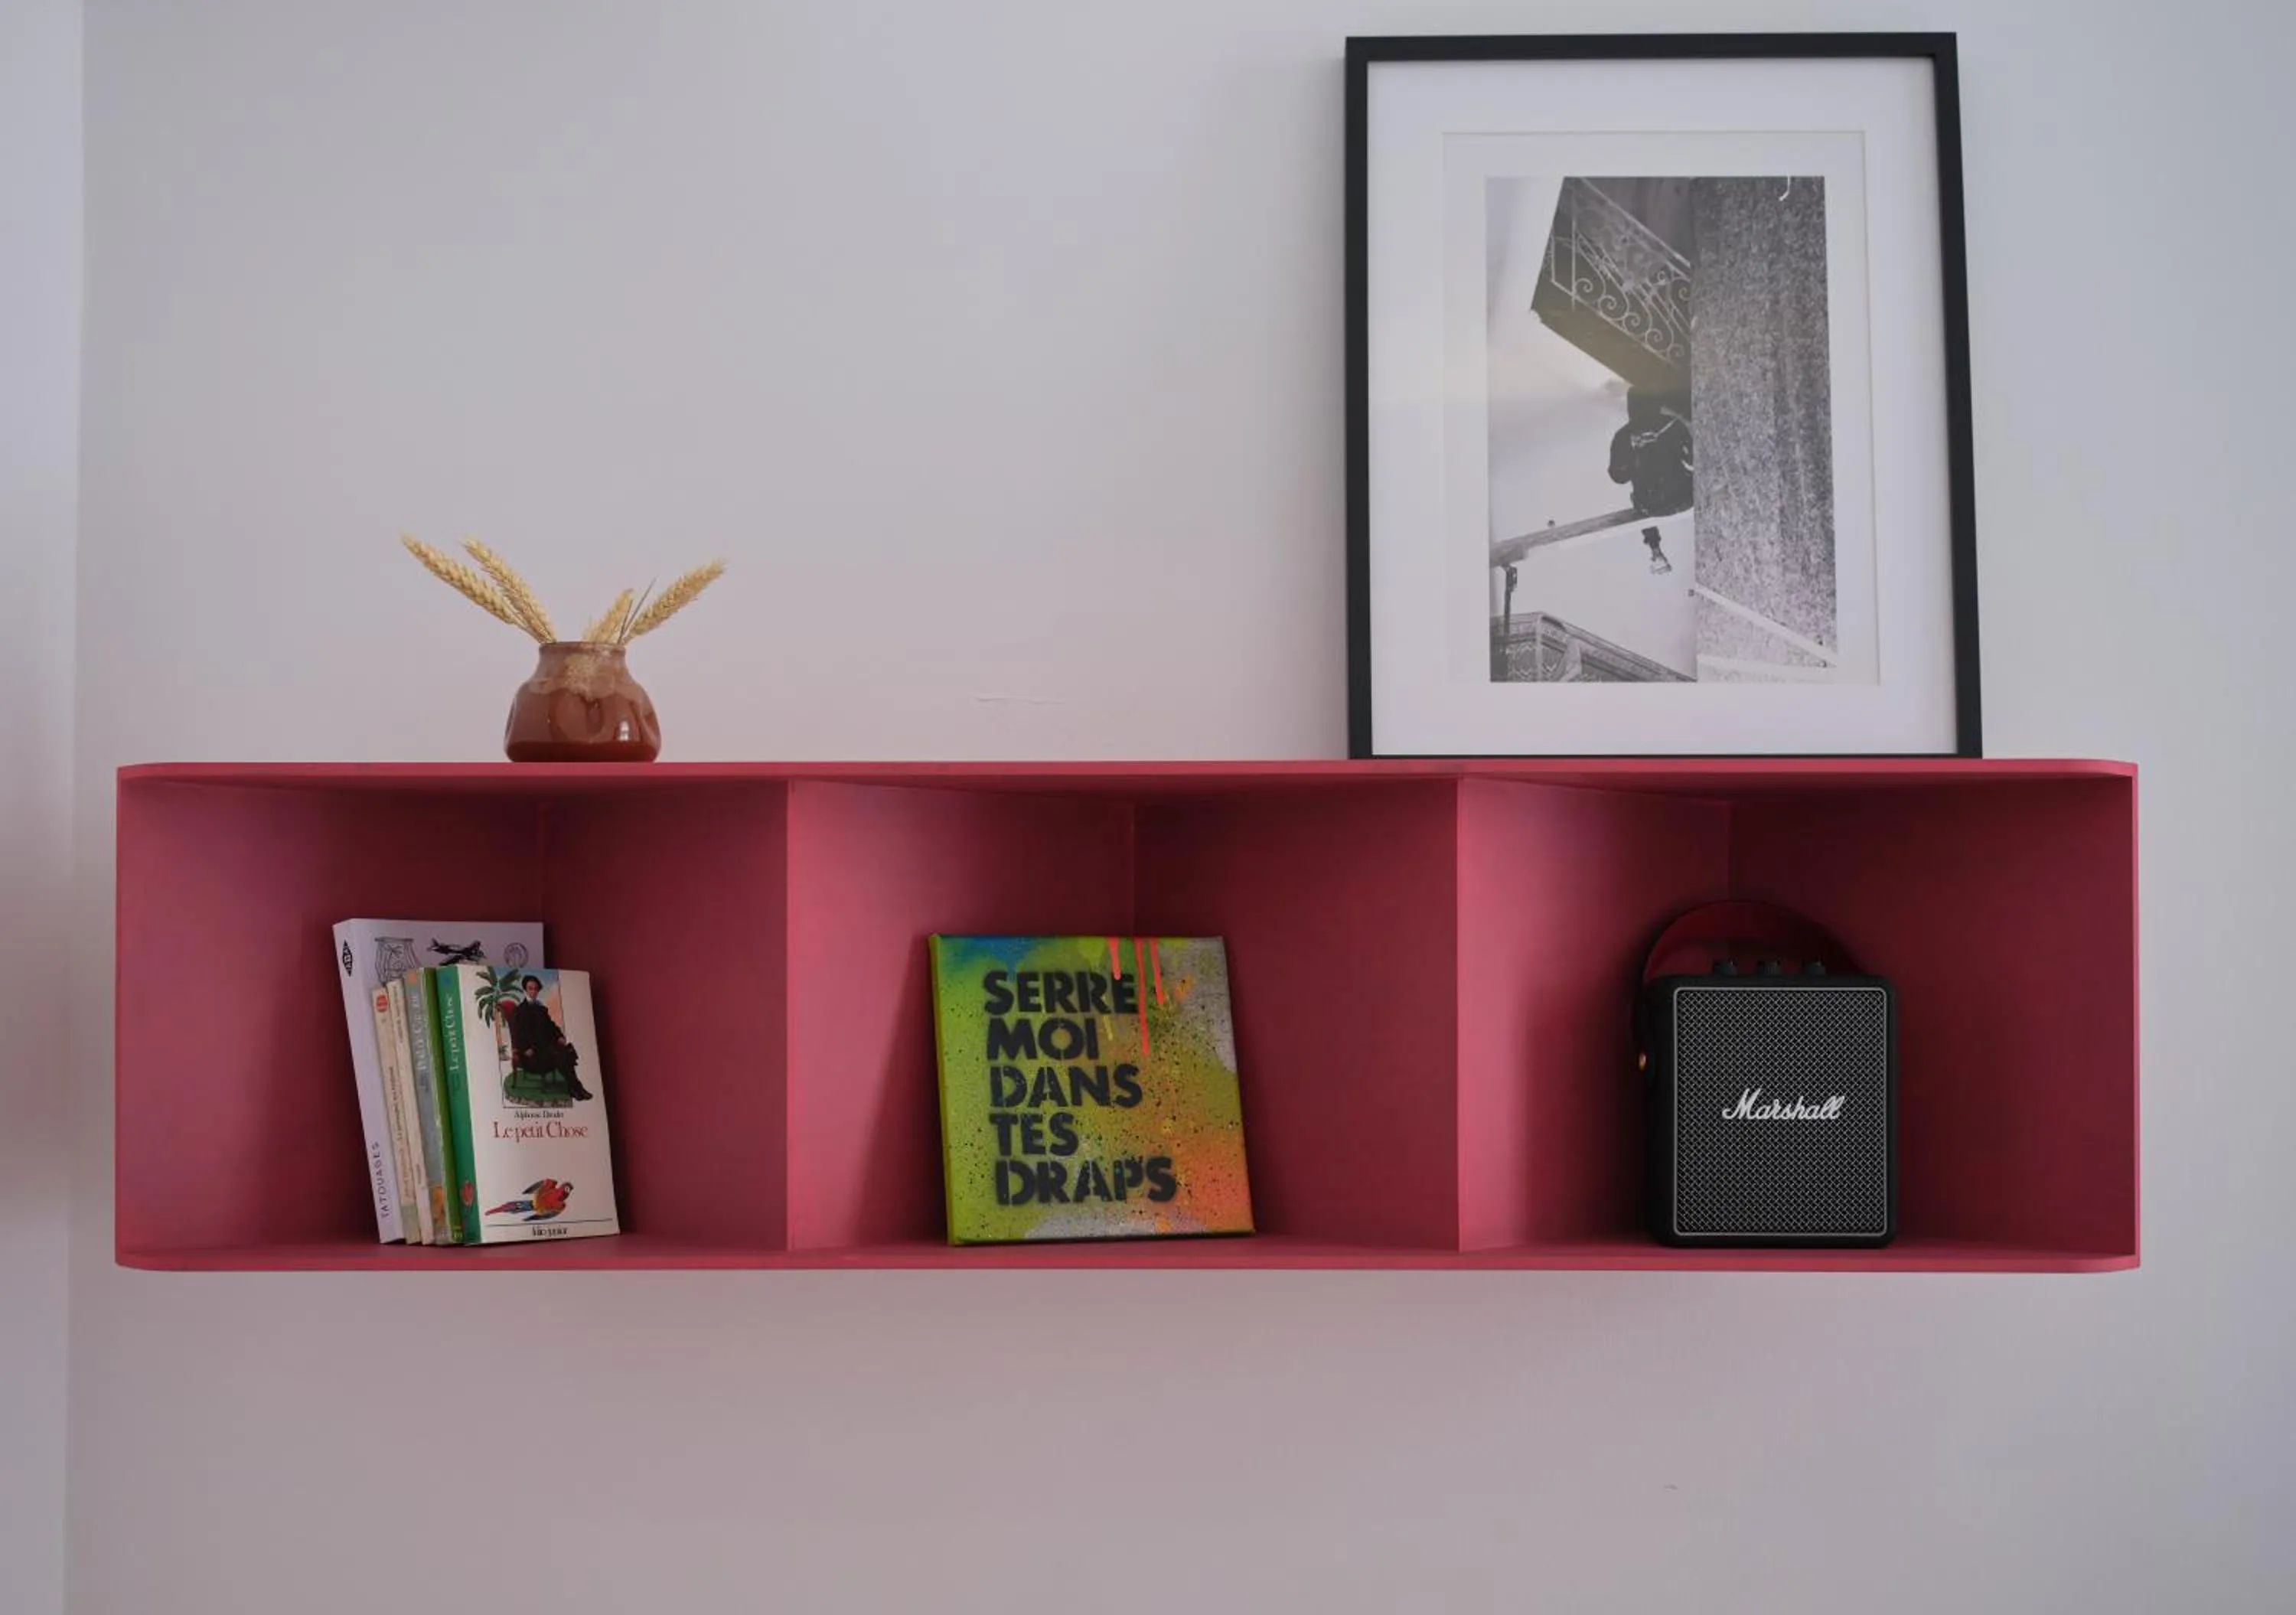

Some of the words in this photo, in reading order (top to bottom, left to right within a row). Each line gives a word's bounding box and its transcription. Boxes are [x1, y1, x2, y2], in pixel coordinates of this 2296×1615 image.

[983, 970, 1139, 1015] SERRE
[987, 1017, 1100, 1061] MOI
[990, 1065, 1143, 1109] DANS
[1722, 1088, 1845, 1120] Marshall
[494, 1121, 514, 1138] Le
[514, 1121, 543, 1143] petit
[546, 1121, 589, 1138] Chose
[990, 1112, 1079, 1157] TES
[372, 1141, 390, 1217] TATOUAGES
[996, 1157, 1177, 1206] DRAPS
